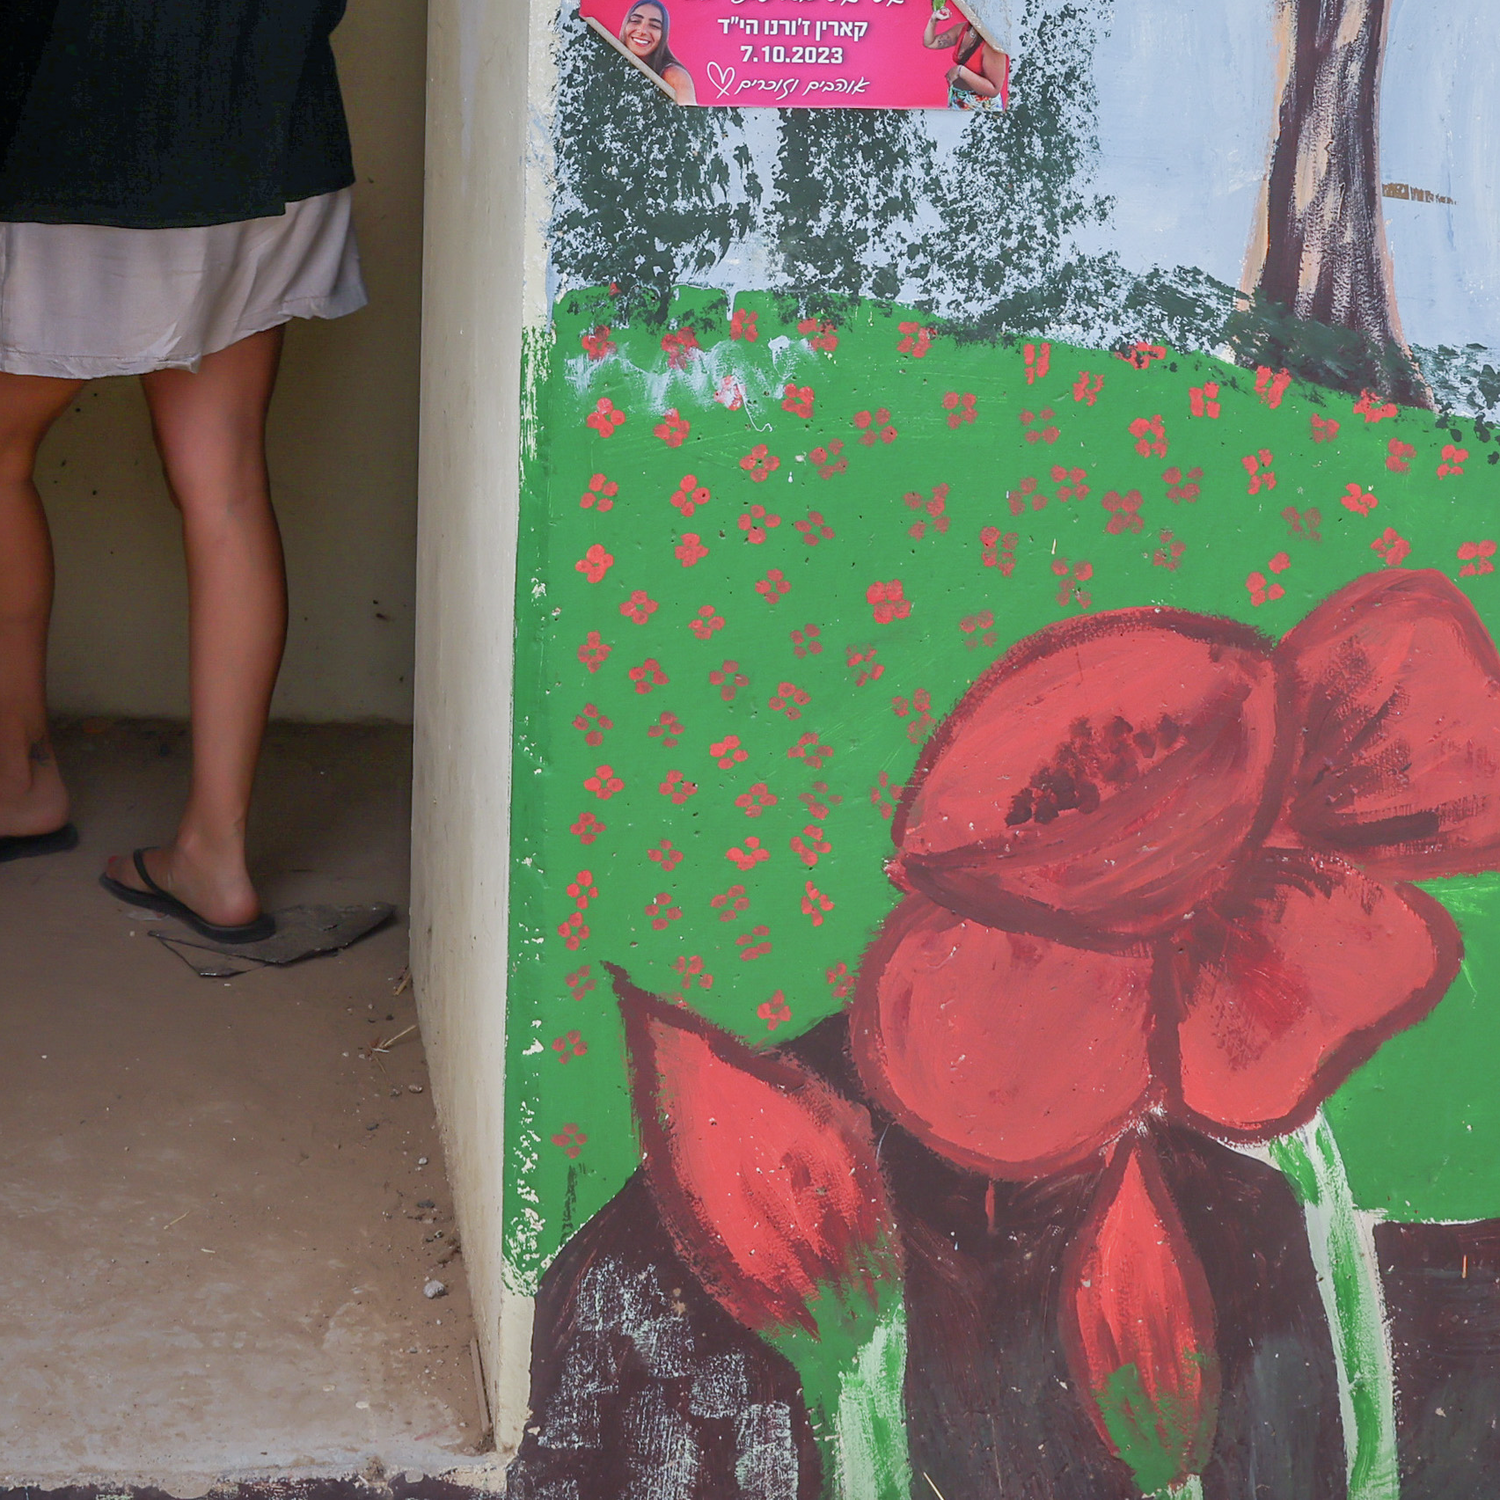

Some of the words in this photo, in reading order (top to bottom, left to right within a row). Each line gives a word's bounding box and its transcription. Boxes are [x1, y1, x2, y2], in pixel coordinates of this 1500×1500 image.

[815, 22, 869, 42] קארין
[740, 45, 844, 64] 7.10.2023
[801, 76, 870, 94] אוהבים
